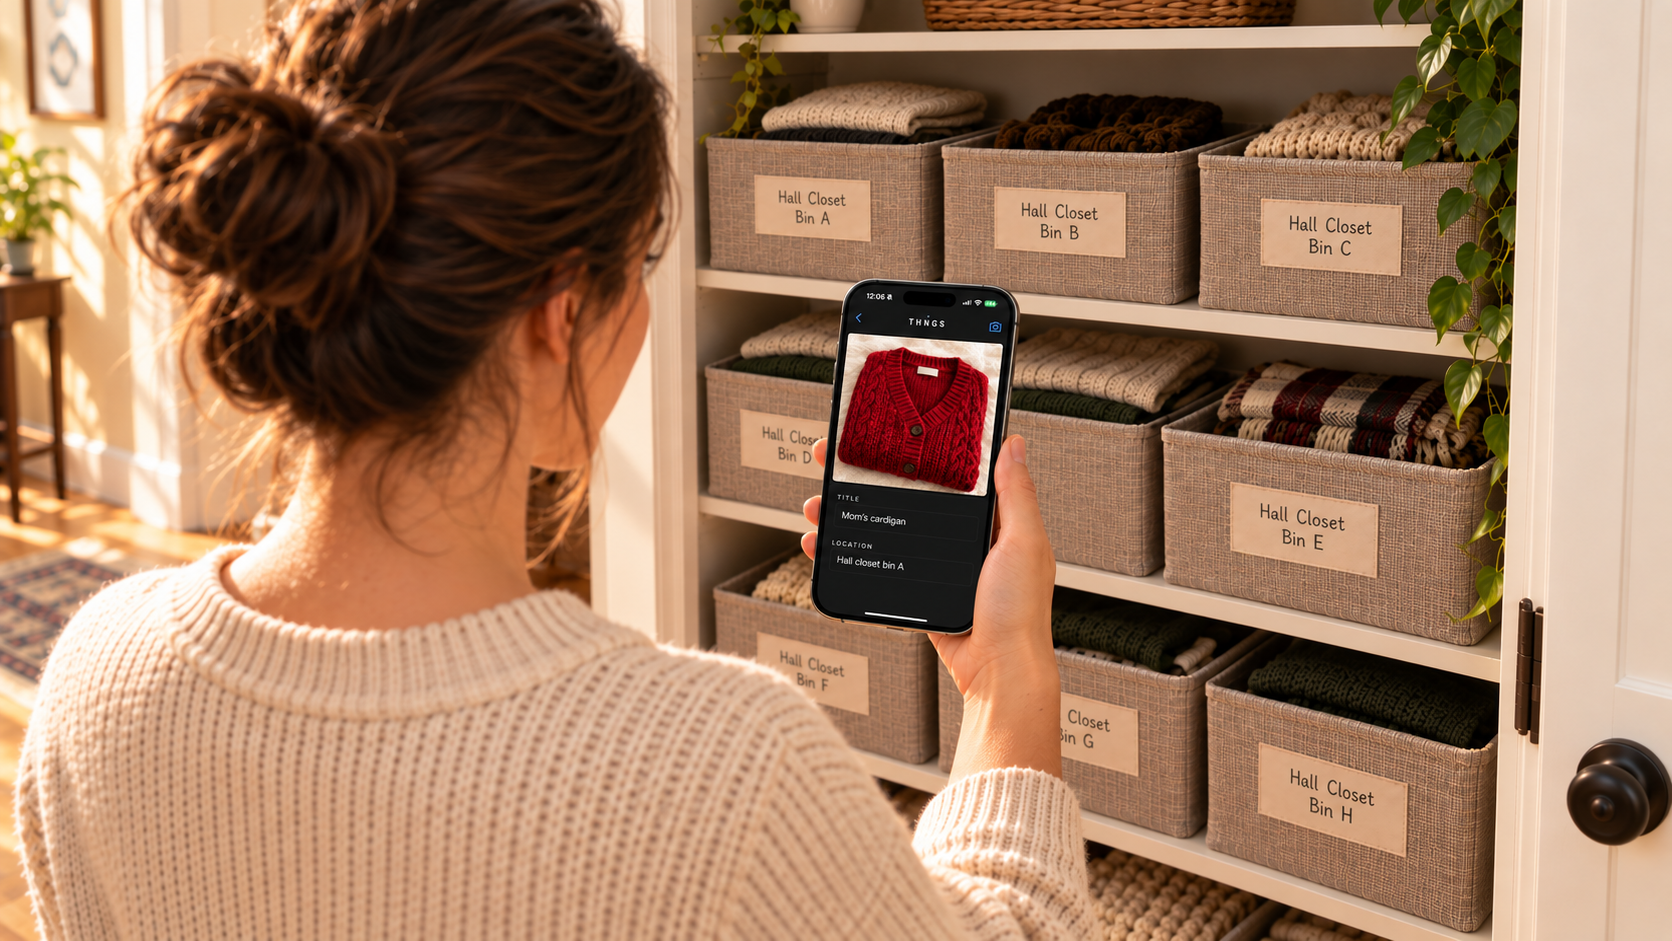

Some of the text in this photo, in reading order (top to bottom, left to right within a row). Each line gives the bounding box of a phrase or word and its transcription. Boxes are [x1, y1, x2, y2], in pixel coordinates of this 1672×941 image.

[778, 190, 846, 207] Hall Closet
[795, 209, 831, 226] Bin A
[1021, 202, 1099, 221] Hall Closet
[1040, 223, 1079, 240] Bin B
[1289, 215, 1373, 235] Hall Closet
[1309, 238, 1352, 256] Bin C
[866, 292, 886, 301] 12:06
[762, 426, 823, 446] Hall Clos
[778, 446, 812, 464] Bin D
[837, 494, 860, 503] TITLE
[841, 511, 907, 527] Mom's cardigan
[1260, 502, 1346, 532] Hall Closet
[831, 540, 873, 550] LOCATION
[1282, 528, 1324, 551] Bin E
[836, 555, 905, 571] Hall closet bin A
[780, 650, 845, 678] Hall Closet
[797, 672, 829, 692] Bin F
[1067, 708, 1111, 733] Closet
[1083, 733, 1094, 749] G
[1290, 768, 1375, 807] Hall Closet
[1309, 796, 1353, 824] Bin H
